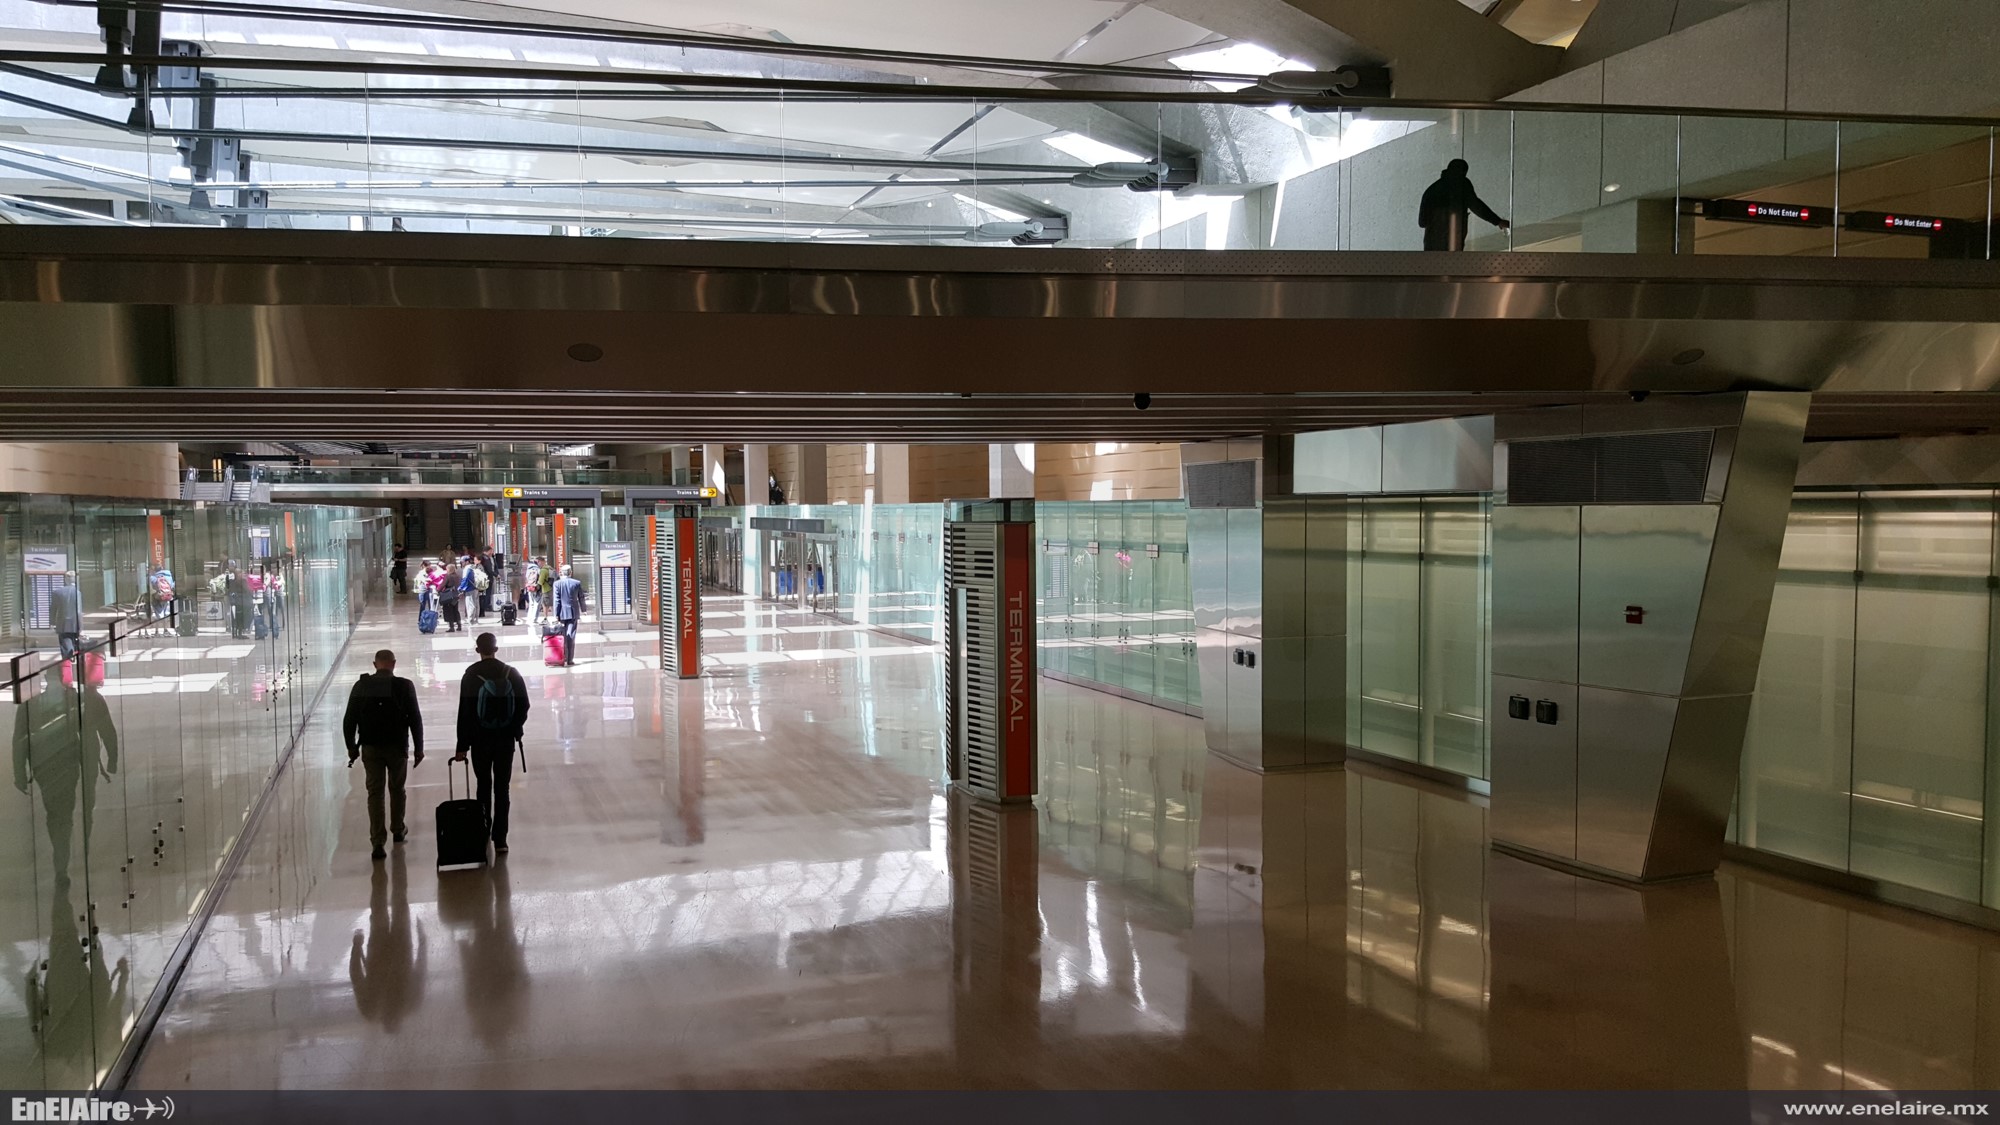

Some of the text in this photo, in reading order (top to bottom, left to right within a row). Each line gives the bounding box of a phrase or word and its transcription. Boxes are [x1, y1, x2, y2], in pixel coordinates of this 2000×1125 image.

[1758, 207, 1799, 217] Do Not Enter
[1894, 218, 1932, 228] Do Not Enter
[651, 544, 659, 598] TERMINAL
[682, 557, 693, 639] TERMINAL
[1009, 590, 1024, 732] TERMINAL
